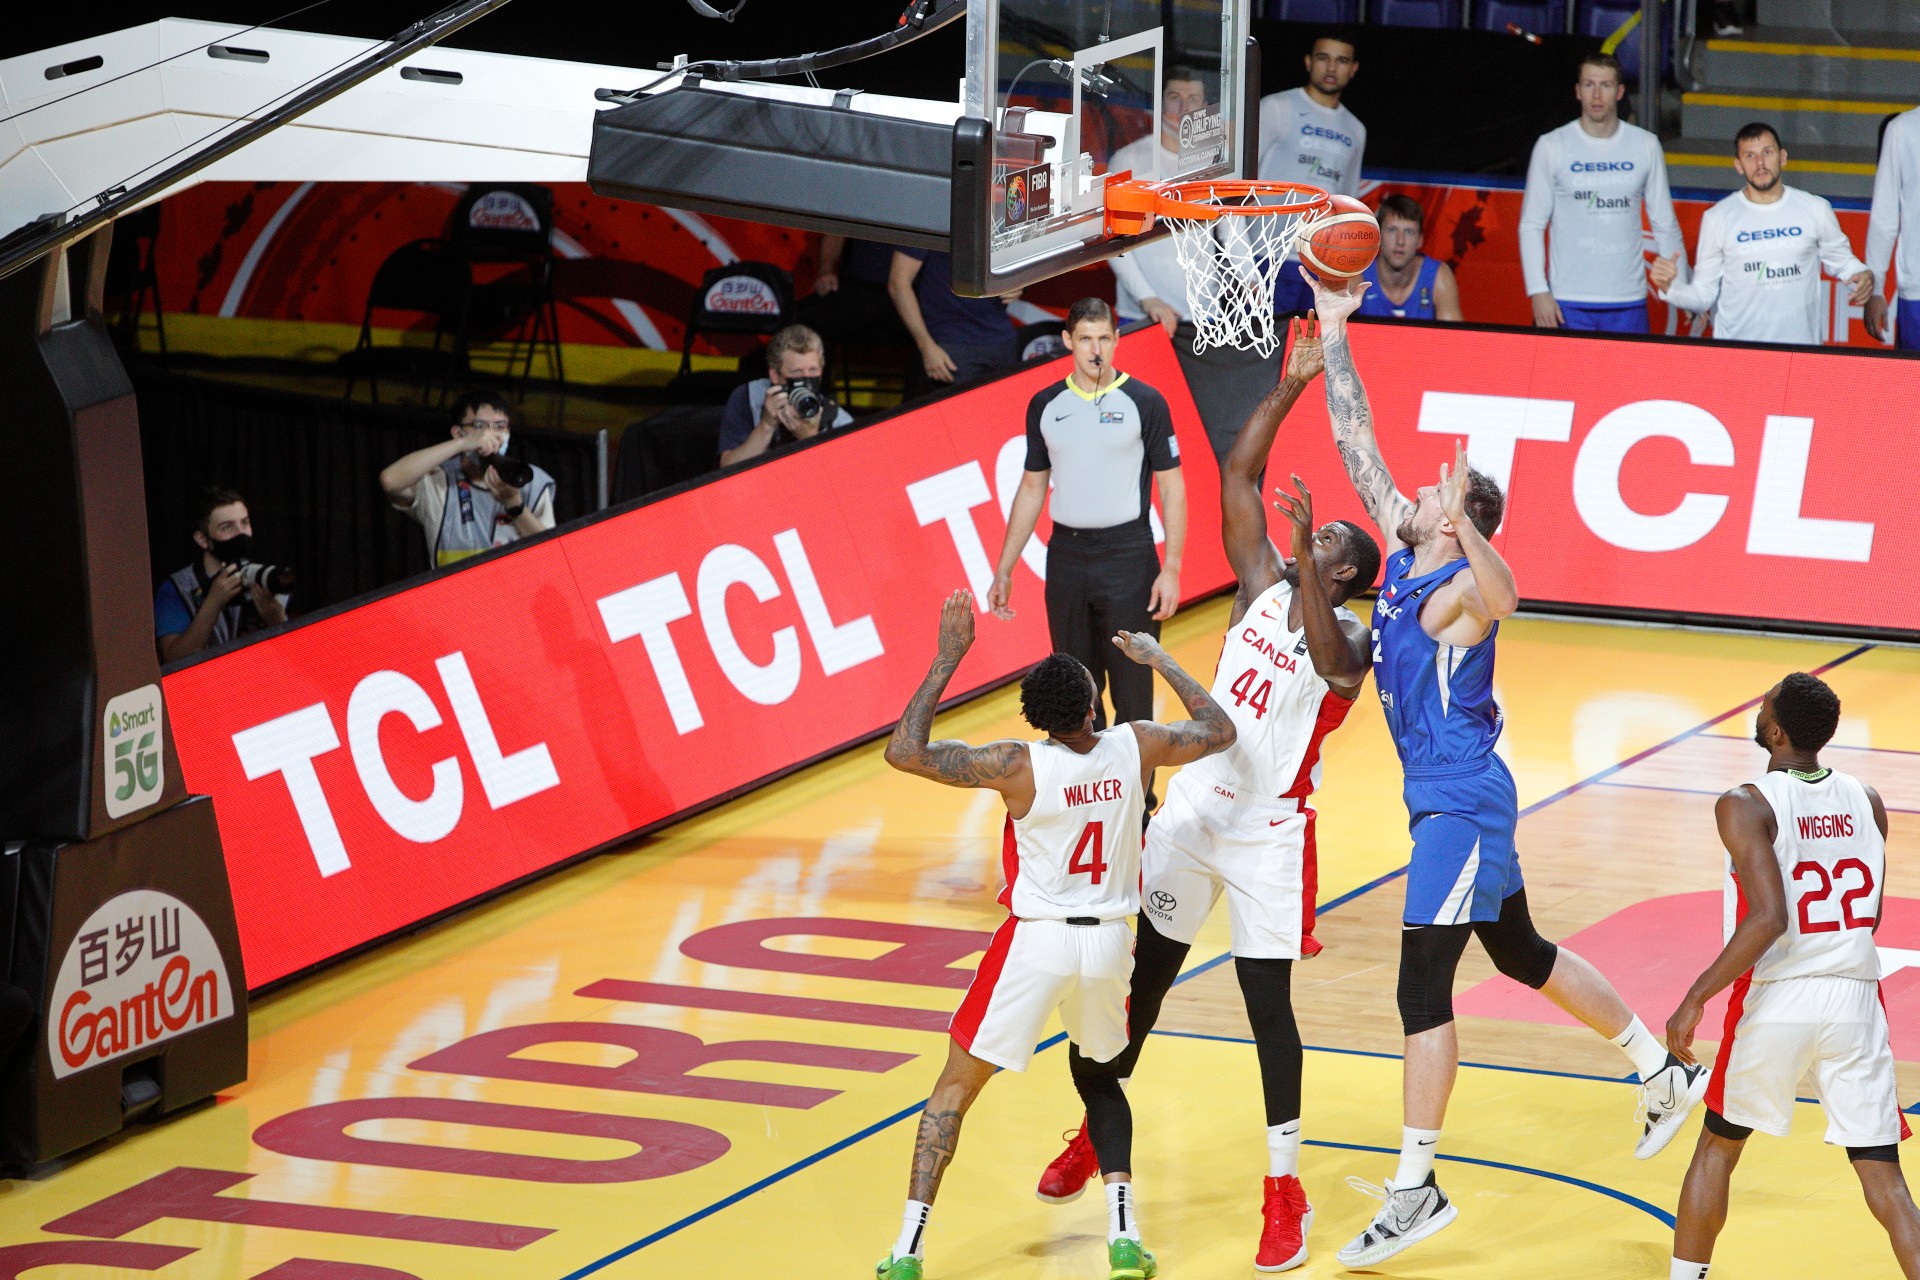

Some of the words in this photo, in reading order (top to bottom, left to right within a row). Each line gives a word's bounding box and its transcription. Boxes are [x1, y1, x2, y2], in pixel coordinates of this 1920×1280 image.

[1301, 124, 1352, 147] ČESKO
[1571, 160, 1634, 172] ČESKO
[1032, 171, 1047, 191] FIBA
[1574, 191, 1592, 200] air
[1597, 196, 1631, 208] bank
[1340, 231, 1373, 240] molten
[1737, 226, 1802, 242] ČESKO
[1744, 262, 1762, 272] air
[1766, 264, 1801, 278] bank
[1417, 391, 1875, 562] TCL
[596, 528, 885, 735] TCL
[1242, 628, 1296, 674] CANADA
[1230, 667, 1272, 720] 44
[122, 701, 155, 731] Smart
[115, 730, 158, 801] 5G
[231, 650, 560, 877] TCL
[1064, 779, 1122, 807] WALKER
[1214, 786, 1235, 799] CAN
[1797, 814, 1854, 839] WIGGINS
[1069, 821, 1107, 885] 4
[1792, 858, 1875, 935] 22
[79, 907, 180, 988] 百岁山
